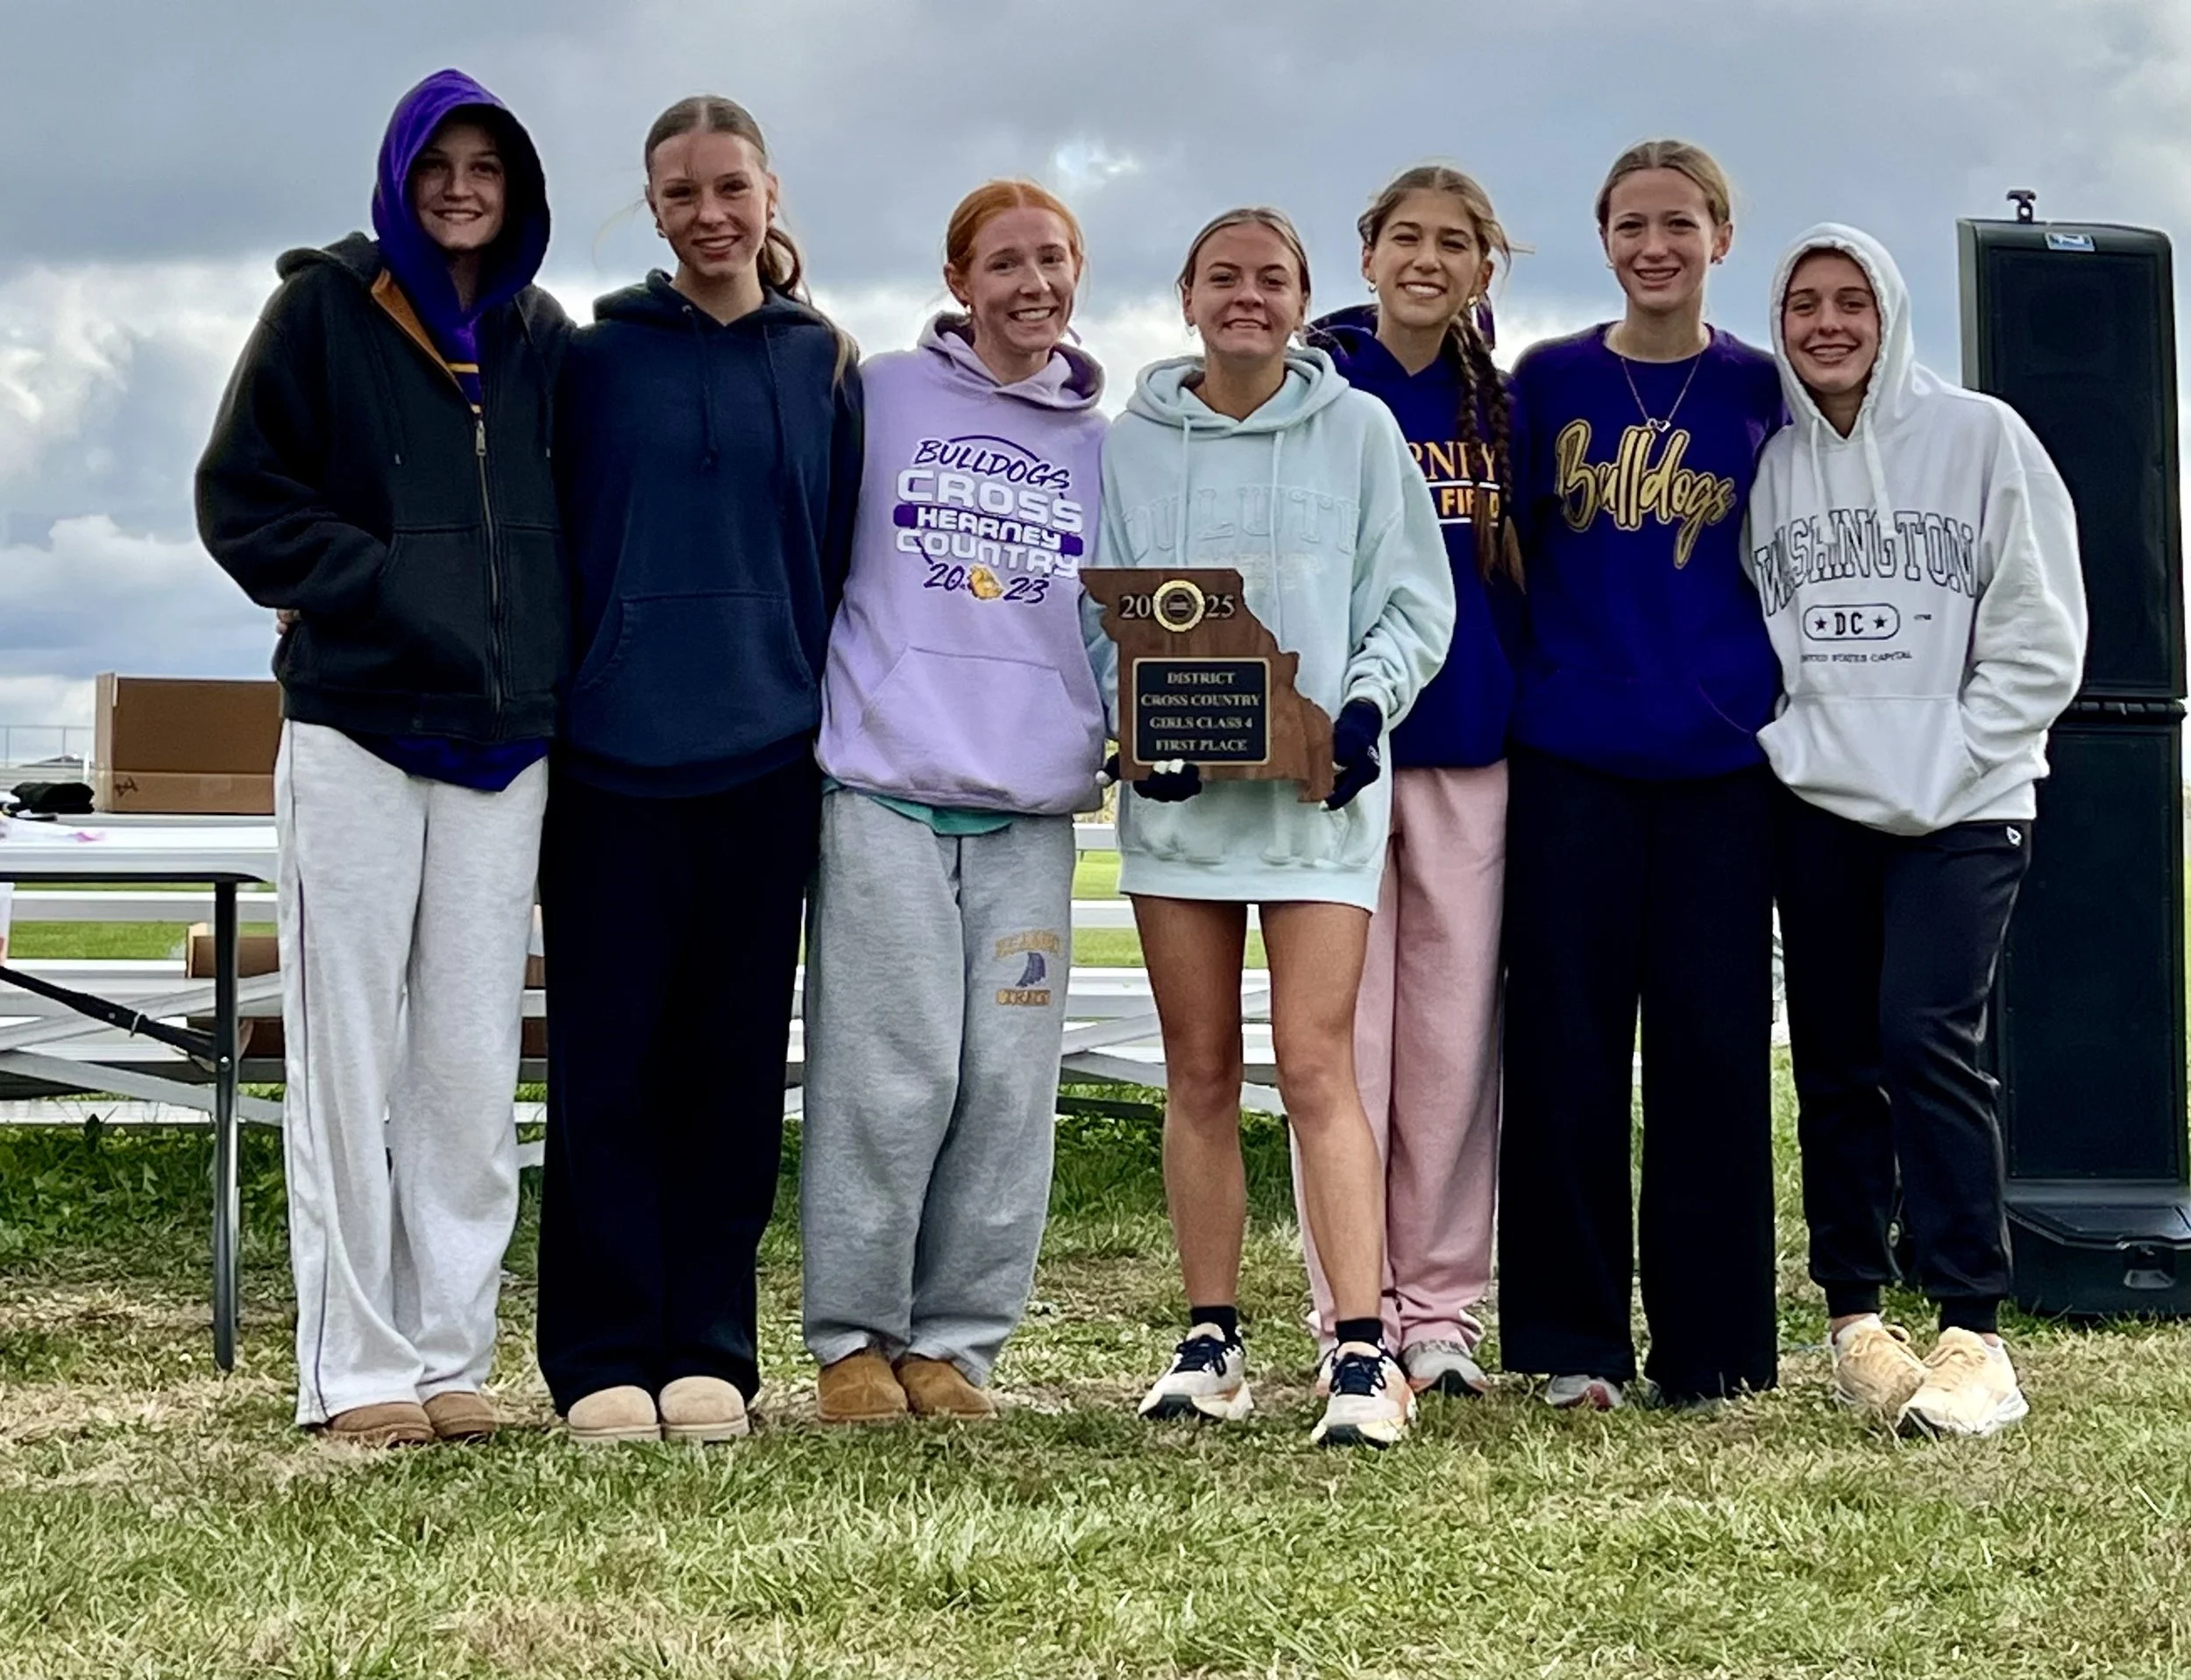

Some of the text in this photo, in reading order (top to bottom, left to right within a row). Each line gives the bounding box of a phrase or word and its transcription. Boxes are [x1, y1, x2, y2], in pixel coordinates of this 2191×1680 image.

[914, 439, 1071, 491] BULLDOGS
[897, 470, 1083, 534] CROSS
[1441, 488, 1500, 519] FIED
[1555, 419, 1737, 569] Bulldogs
[896, 528, 1079, 578] COUNTRY
[1754, 508, 1975, 617] WSHINGTON
[924, 563, 1050, 604] 20 23
[1121, 595, 1235, 619] 20 25
[1834, 612, 1863, 635] DC
[1167, 671, 1235, 684] DISTRICT
[1140, 693, 1260, 706] CROSS COUNTRY
[1149, 717, 1253, 728] GIRLS CLASS 4
[1155, 739, 1247, 751] FIRST PLACE
